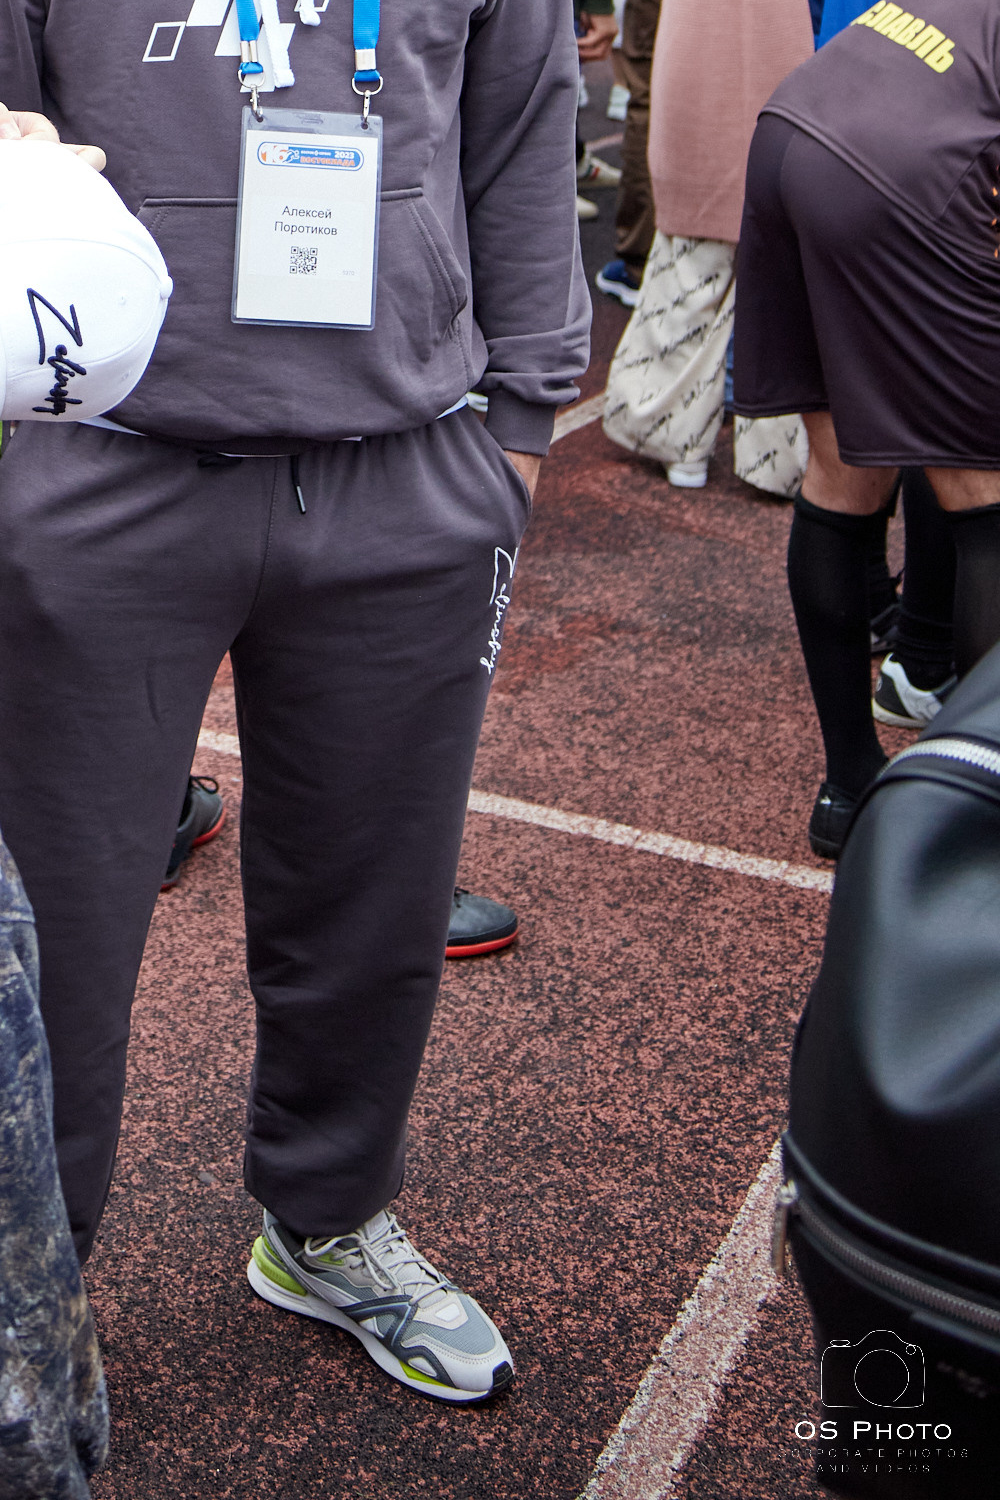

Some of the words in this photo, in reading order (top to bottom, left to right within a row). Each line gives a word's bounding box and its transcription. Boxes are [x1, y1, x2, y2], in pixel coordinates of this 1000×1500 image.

[334, 150, 355, 159] 2023
[282, 205, 332, 219] Алексей
[274, 221, 338, 236] Поротиков
